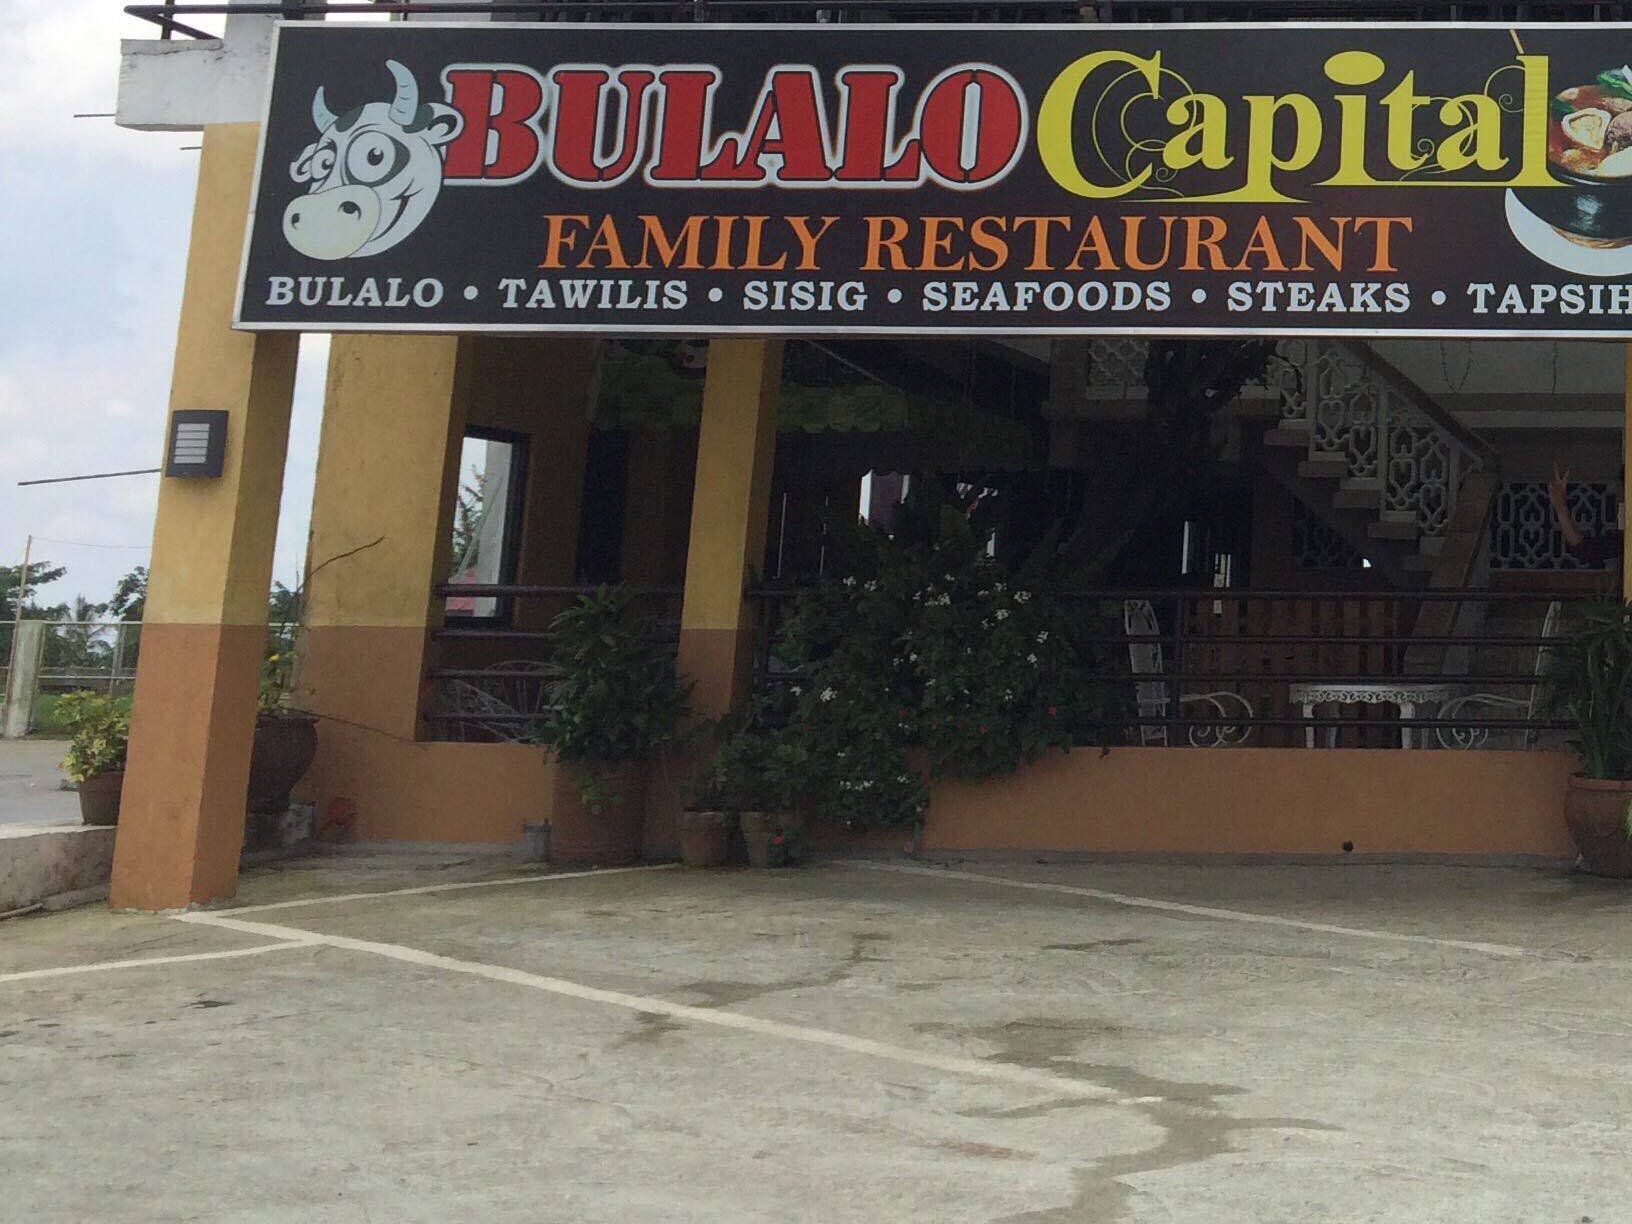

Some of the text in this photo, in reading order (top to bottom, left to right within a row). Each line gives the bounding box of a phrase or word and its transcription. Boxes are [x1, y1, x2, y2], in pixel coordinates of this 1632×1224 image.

[443, 50, 1576, 203] BULALO Capital
[538, 214, 1413, 273] FAMILY RESTAURANT
[265, 276, 445, 308] BULALO
[498, 278, 689, 311] TAWILIS
[742, 280, 868, 312] SISIG
[922, 280, 1172, 313] SEAFOODS
[1227, 281, 1412, 314] STEAKS
